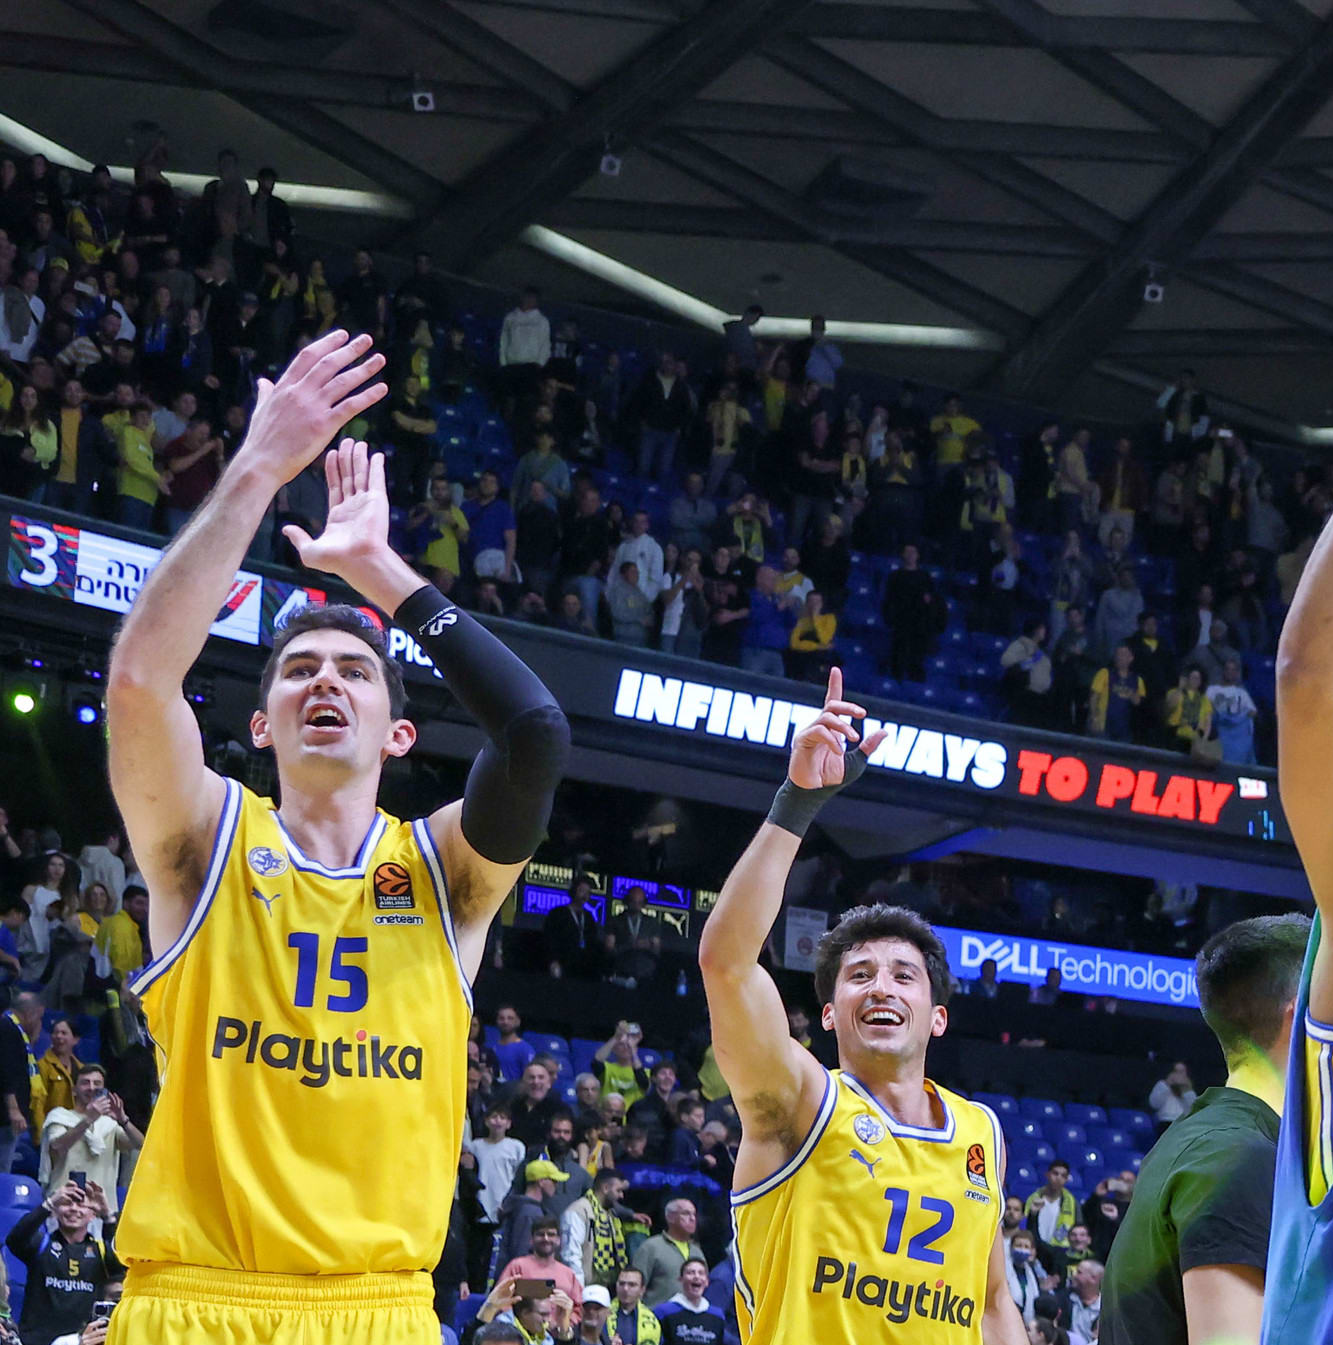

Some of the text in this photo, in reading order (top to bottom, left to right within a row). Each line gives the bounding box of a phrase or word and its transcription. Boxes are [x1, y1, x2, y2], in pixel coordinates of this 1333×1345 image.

[19, 524, 59, 588] 3
[75, 575, 136, 604] טחים
[863, 720, 1007, 789] WAYS
[1018, 750, 1088, 801] TO
[1095, 764, 1235, 824] PLAY
[374, 914, 424, 925] oneteam
[288, 931, 368, 1013] 15
[960, 936, 1198, 1003] DELL Technologi
[211, 1014, 423, 1088] Playtika
[881, 1186, 956, 1265] 12
[45, 1275, 94, 1293] Playtika
[68, 1258, 80, 1277] 5
[812, 1254, 976, 1330] Playtika
